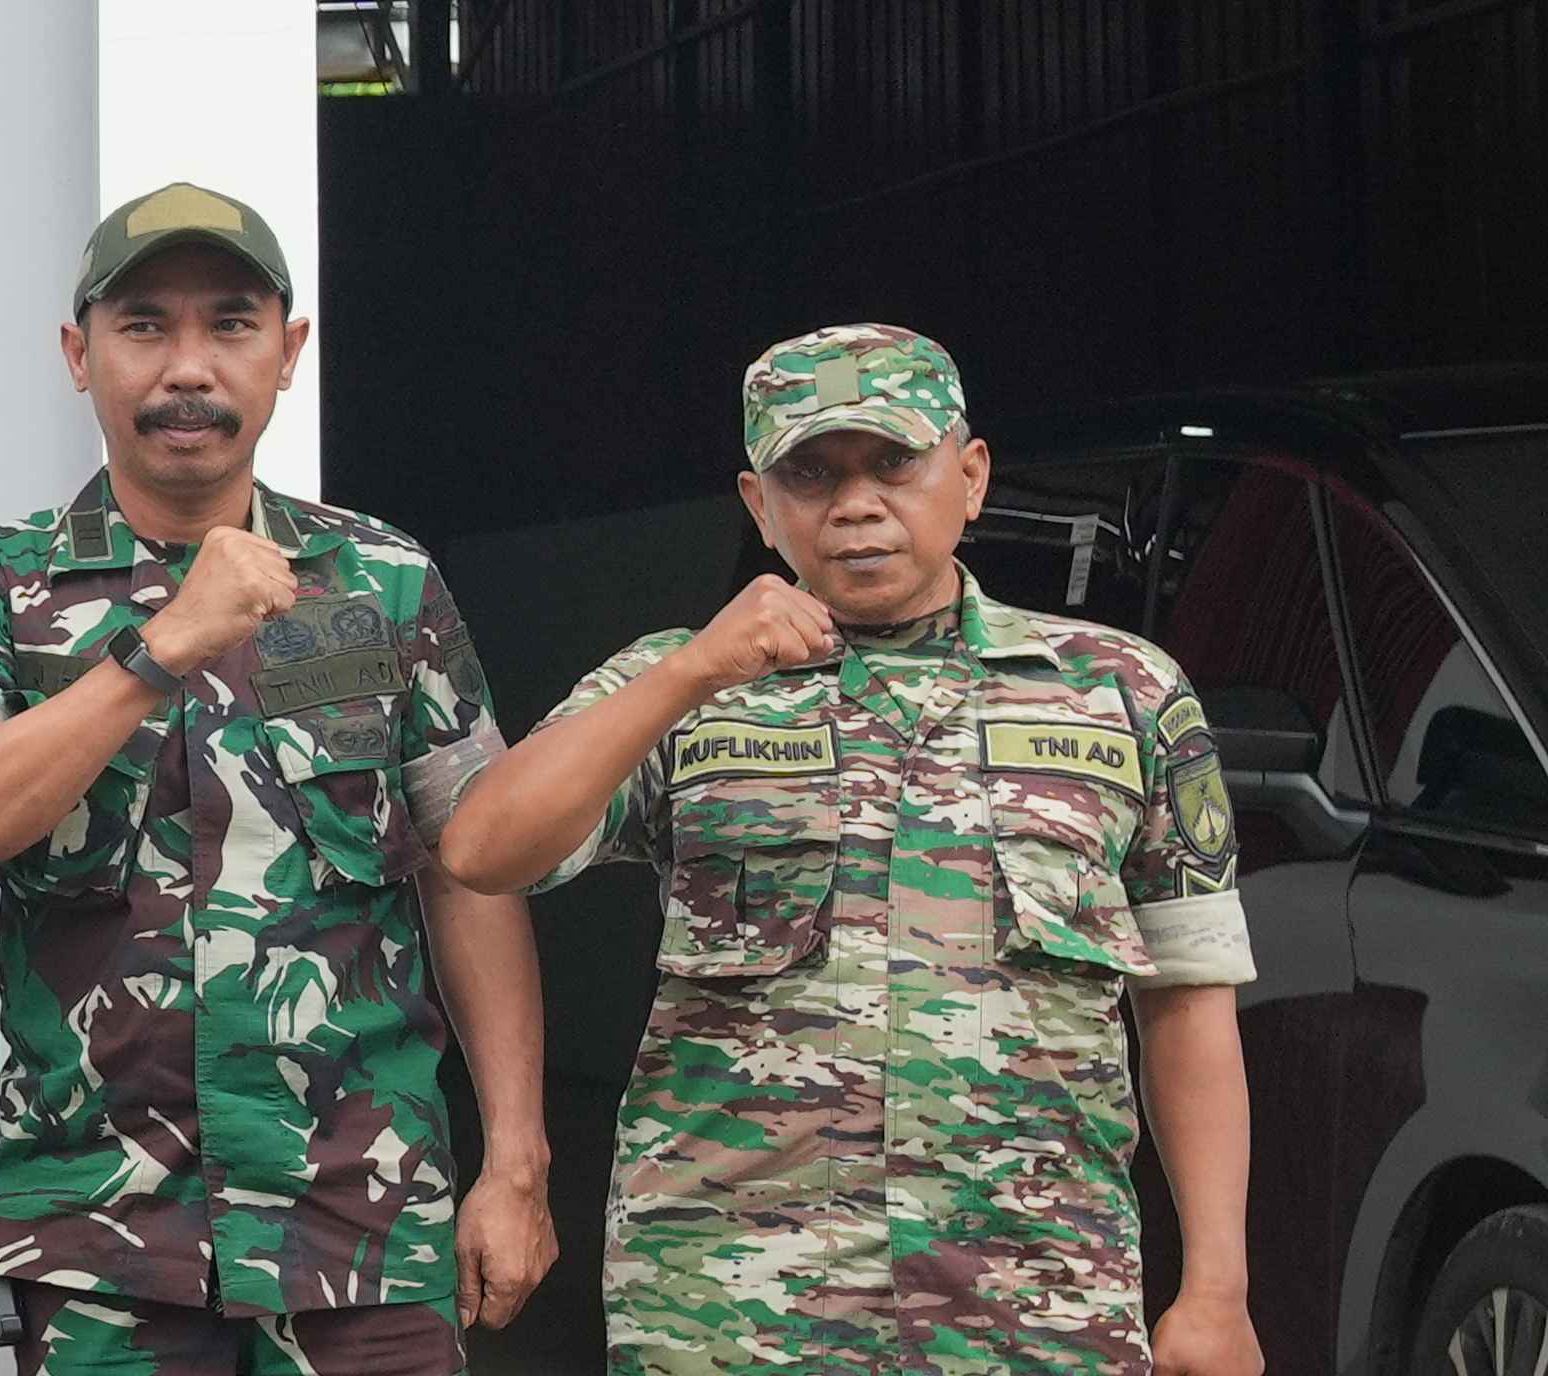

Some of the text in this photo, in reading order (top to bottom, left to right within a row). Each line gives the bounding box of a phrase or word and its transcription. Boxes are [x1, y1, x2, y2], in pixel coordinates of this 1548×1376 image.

[268, 660, 396, 704] TNI AD
[677, 735, 824, 770] MUFLIKHIN
[1027, 736, 1127, 769] TNI AD
